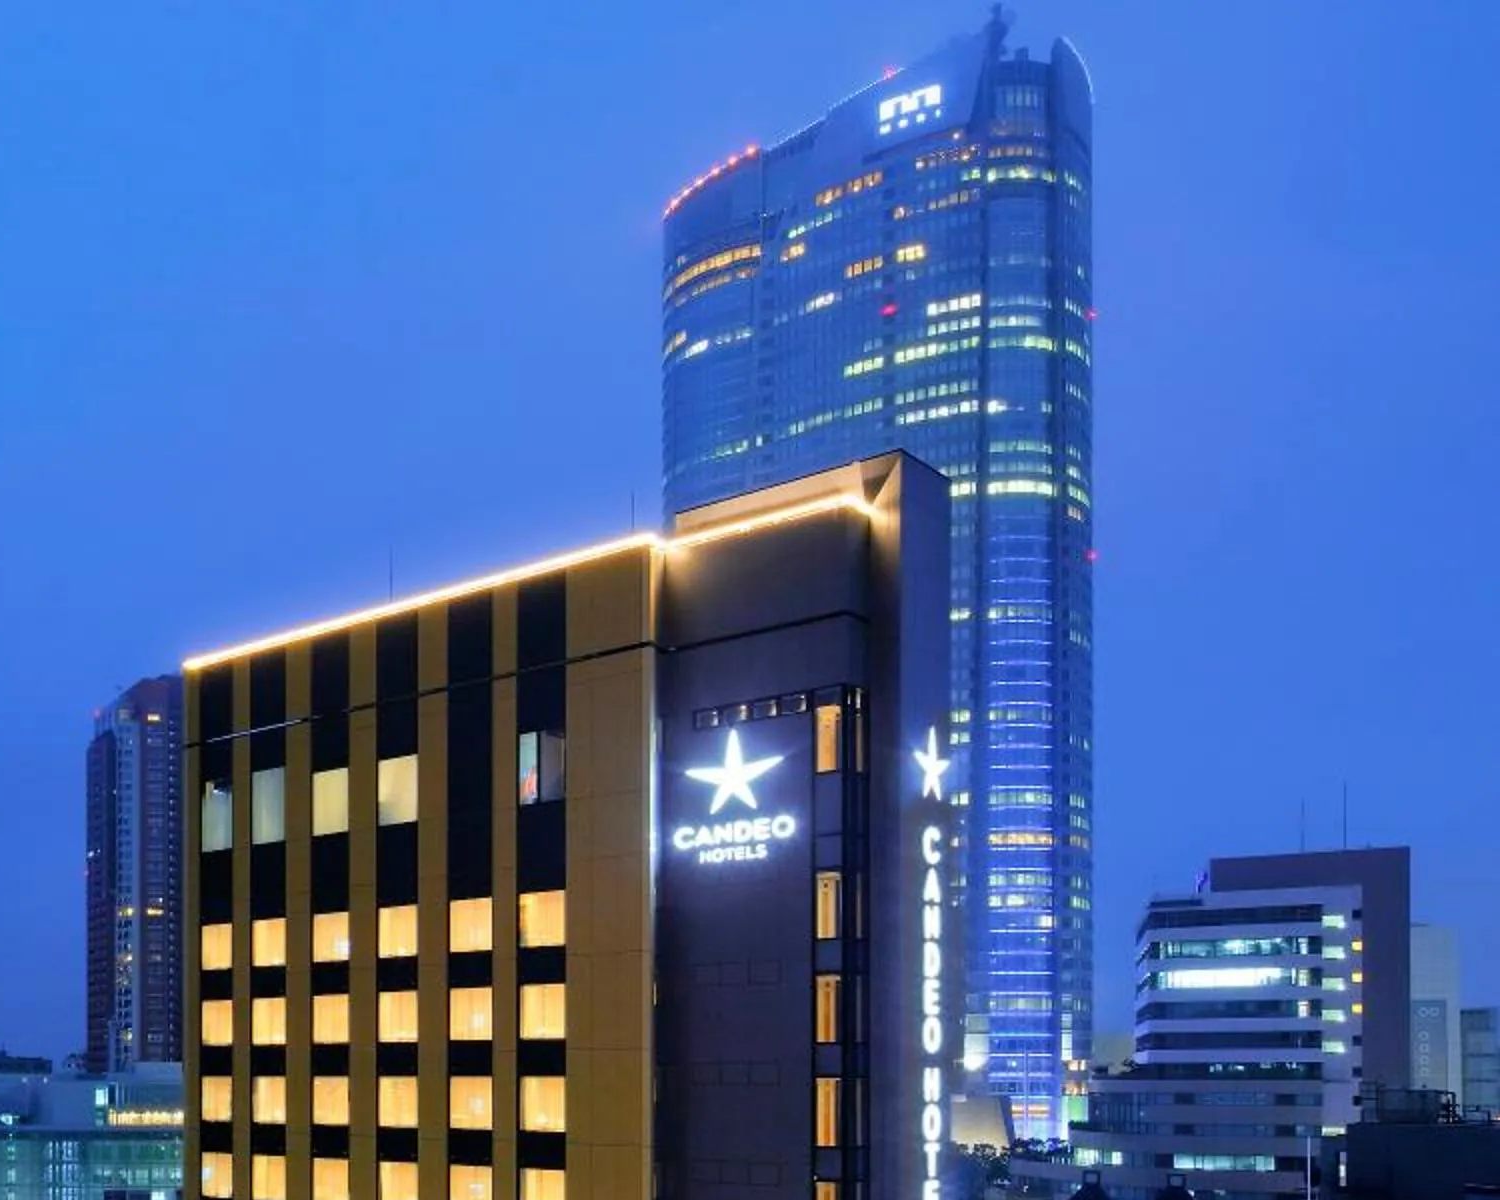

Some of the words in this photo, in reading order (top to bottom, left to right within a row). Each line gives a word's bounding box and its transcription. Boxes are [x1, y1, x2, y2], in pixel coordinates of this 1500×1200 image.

[673, 814, 796, 850] CANDEO
[699, 843, 769, 864] HOTELS
[922, 825, 942, 1054] CANDEO
